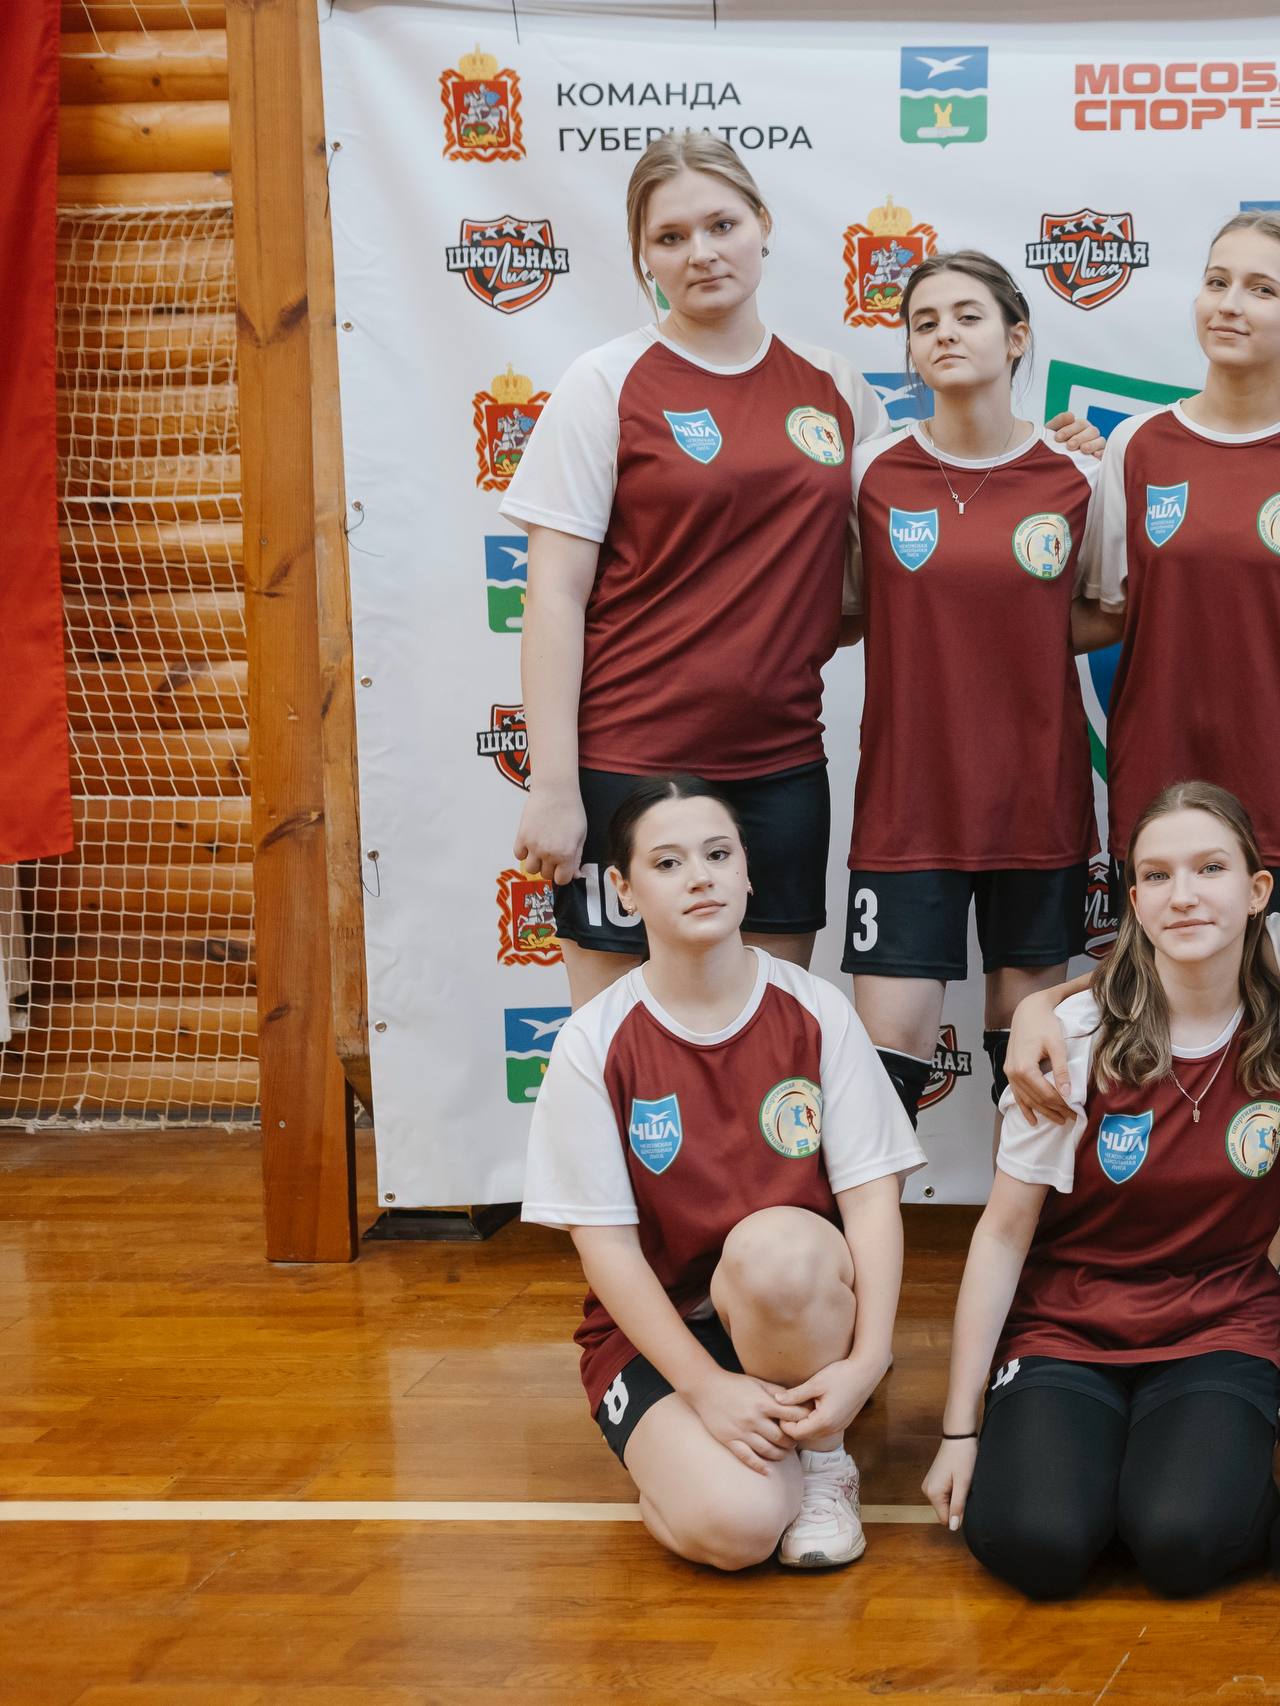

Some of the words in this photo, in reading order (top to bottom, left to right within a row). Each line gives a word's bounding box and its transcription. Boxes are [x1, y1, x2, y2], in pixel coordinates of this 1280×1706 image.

[557, 82, 742, 110] КОМАНДА
[1074, 97, 1265, 131] СПОРТ
[559, 125, 813, 151] ГУБЕРТОРА
[893, 527, 934, 542] ЧШЛ
[853, 888, 878, 952] 3
[631, 1120, 679, 1140] ЧШЛ
[1101, 1131, 1145, 1152] ЧШЛ
